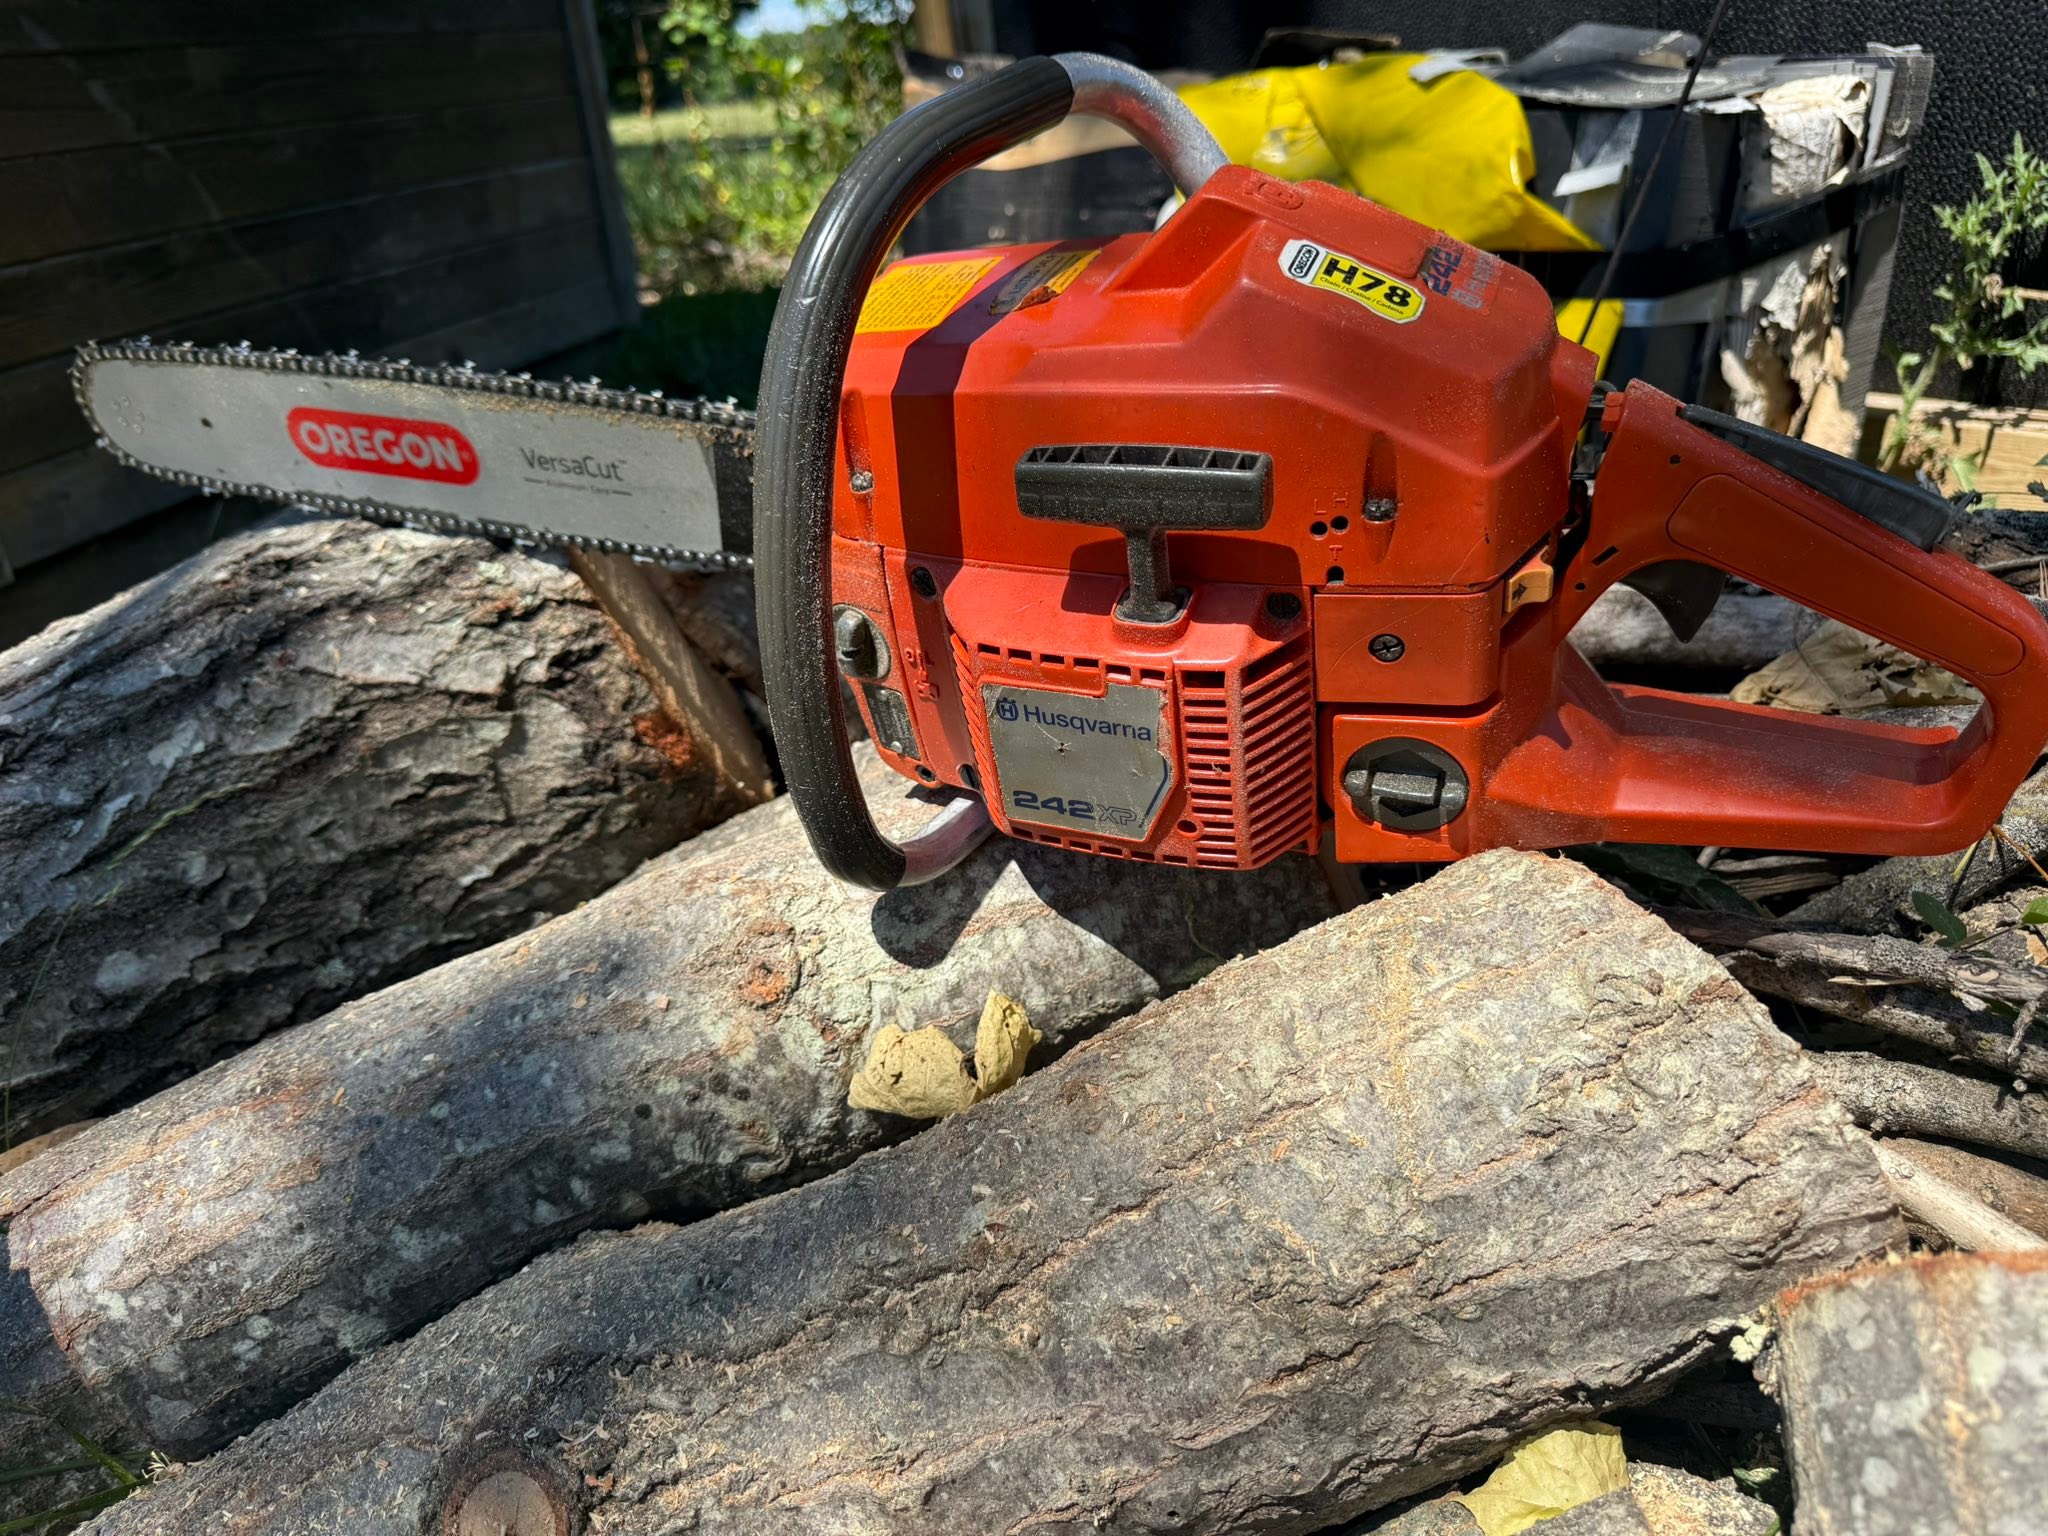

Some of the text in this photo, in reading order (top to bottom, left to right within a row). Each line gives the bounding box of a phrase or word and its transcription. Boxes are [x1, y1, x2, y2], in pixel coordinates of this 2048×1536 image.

[1294, 248, 1315, 275] OREGON
[1319, 276, 1341, 289] Chain
[1323, 257, 1412, 307] H78
[300, 420, 464, 473] OREGON
[1023, 704, 1151, 741] Husqvarna
